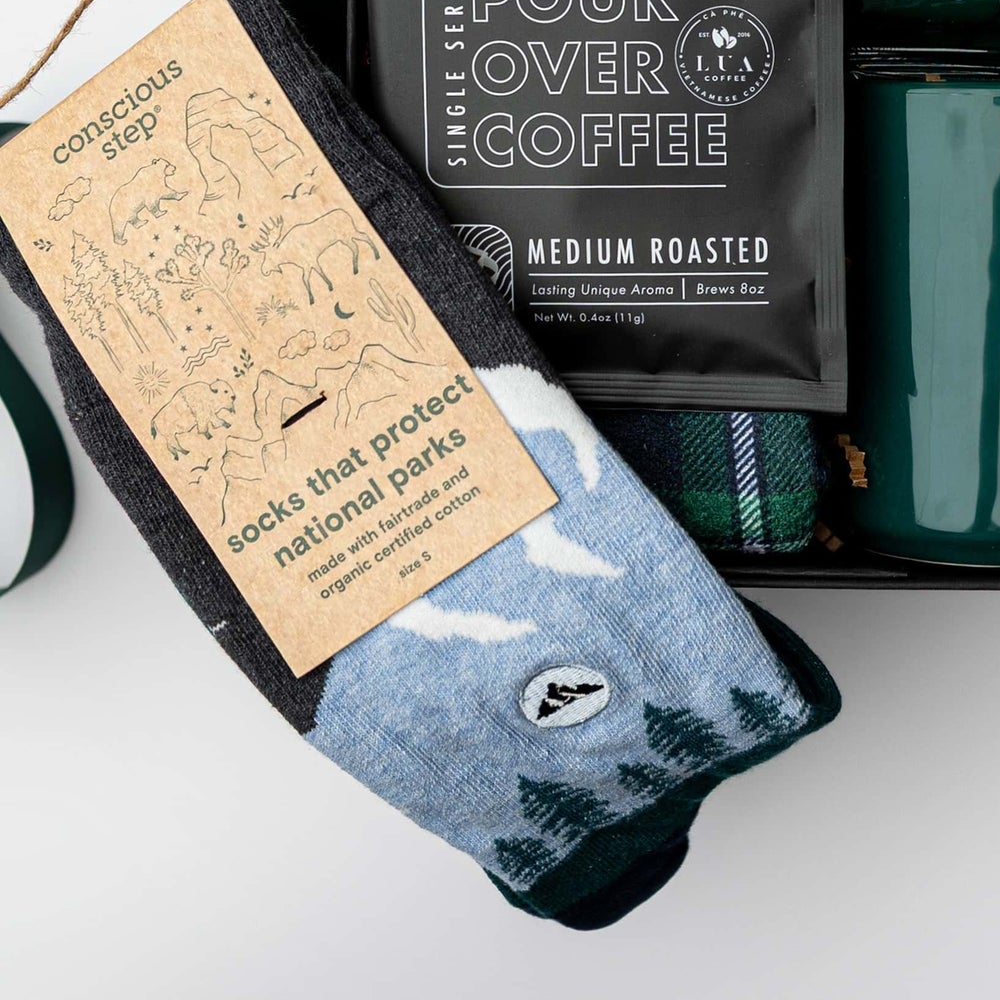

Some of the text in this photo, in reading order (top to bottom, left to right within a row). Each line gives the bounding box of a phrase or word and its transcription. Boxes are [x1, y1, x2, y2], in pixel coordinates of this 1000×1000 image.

[472, 40, 670, 96] OVER
[679, 61, 771, 102] VIETNAMESE COFFEE
[53, 60, 183, 164] conscious
[446, 70, 468, 167] SINGLE
[473, 112, 728, 169] COFFEE
[528, 237, 769, 265] MEDIUM ROASTED
[531, 283, 674, 298] Lasting Unique Aroma
[696, 283, 766, 295] Brews 8oz
[534, 312, 645, 325] Net Wt. 0.4oz (11g)
[227, 374, 474, 553] socks that protect
[273, 428, 467, 568] national parks
[307, 465, 470, 584] made with fairtrade and
[320, 485, 481, 600] organic certified cotton
[399, 551, 432, 579] size S
